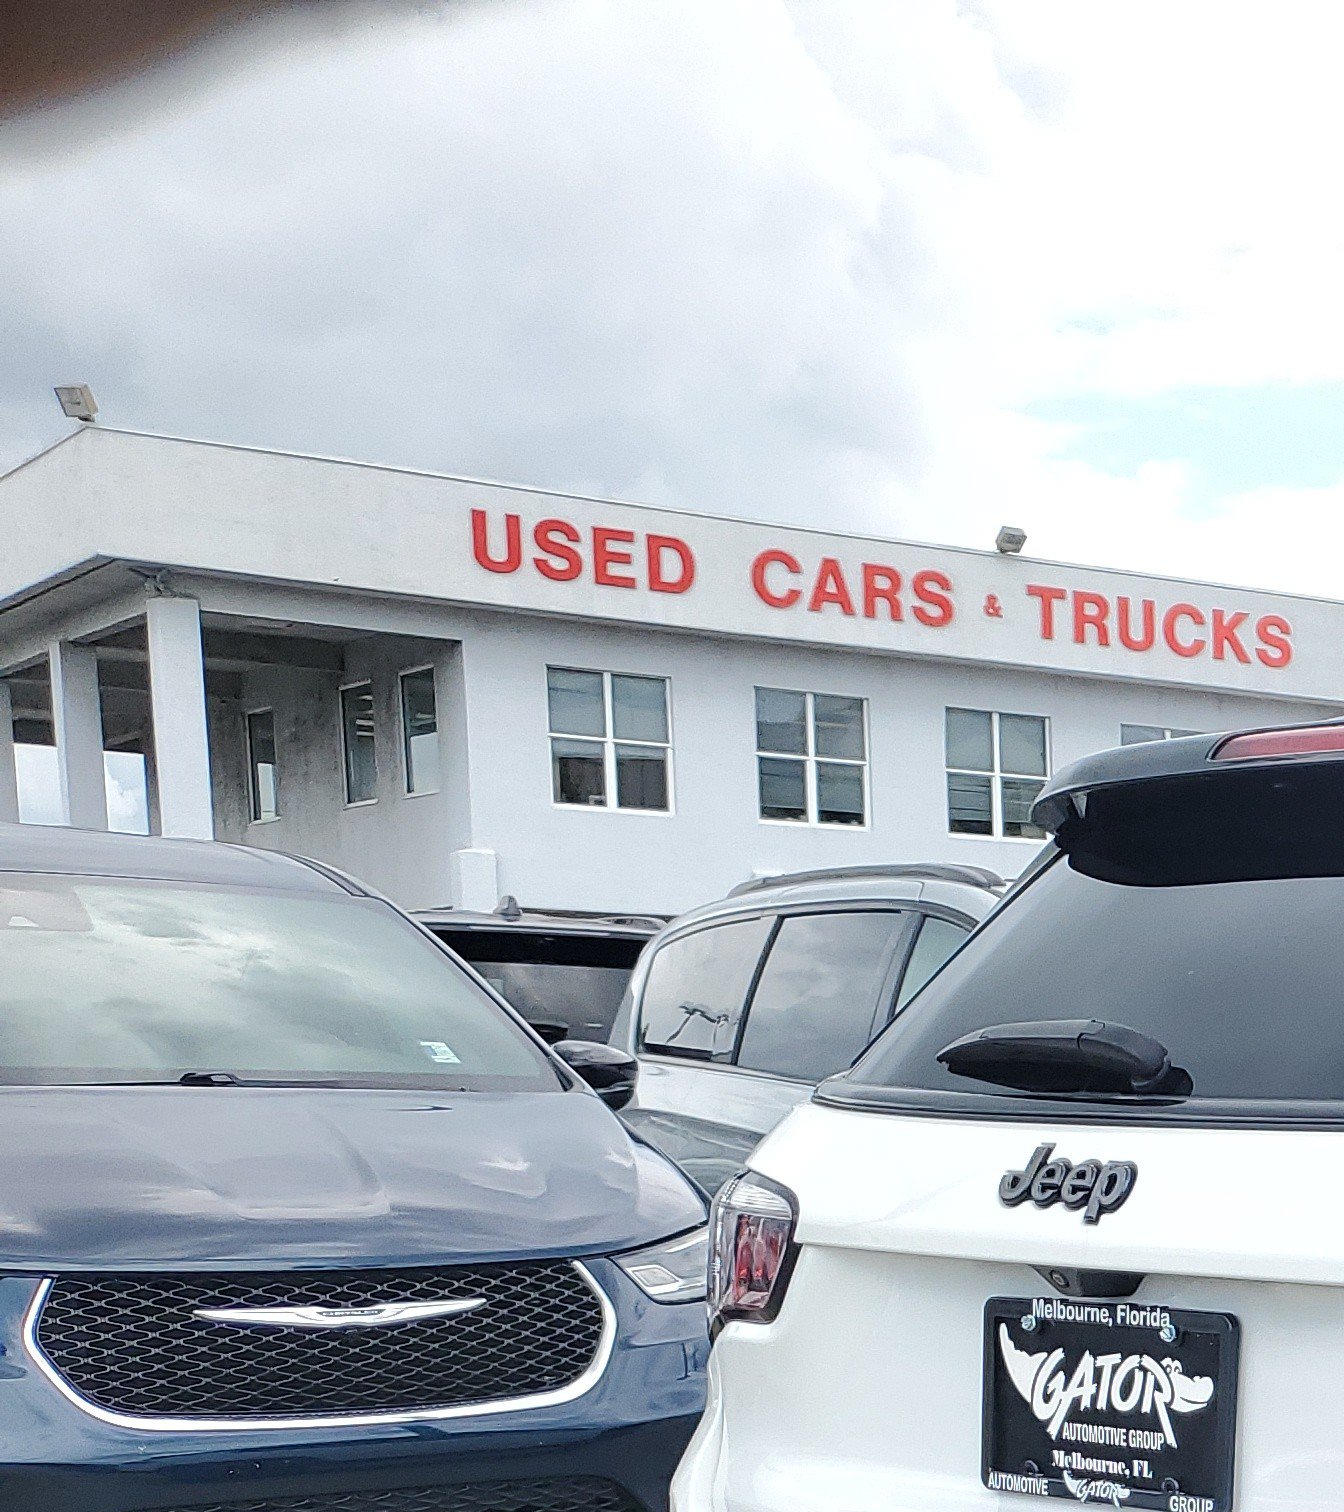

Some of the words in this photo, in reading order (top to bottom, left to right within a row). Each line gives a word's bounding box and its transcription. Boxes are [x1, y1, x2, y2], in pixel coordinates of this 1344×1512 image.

[470, 508, 696, 595] USED
[750, 547, 956, 629] CARS
[984, 594, 1004, 620] &
[1026, 583, 1294, 669] TRUCKS
[999, 1142, 1138, 1225] Jeep
[1032, 1298, 1113, 1327] Melbourne,
[1116, 1304, 1171, 1328] Florida
[1031, 1347, 1177, 1449] GATOR
[1063, 1422, 1128, 1447] AUTOMOTIVE
[1128, 1429, 1165, 1451] GROUP
[1051, 1450, 1131, 1477] Melbourne,
[1132, 1459, 1153, 1479] FL
[988, 1472, 1049, 1496] AUTOMOTIVE
[1075, 1478, 1122, 1509] GATOR
